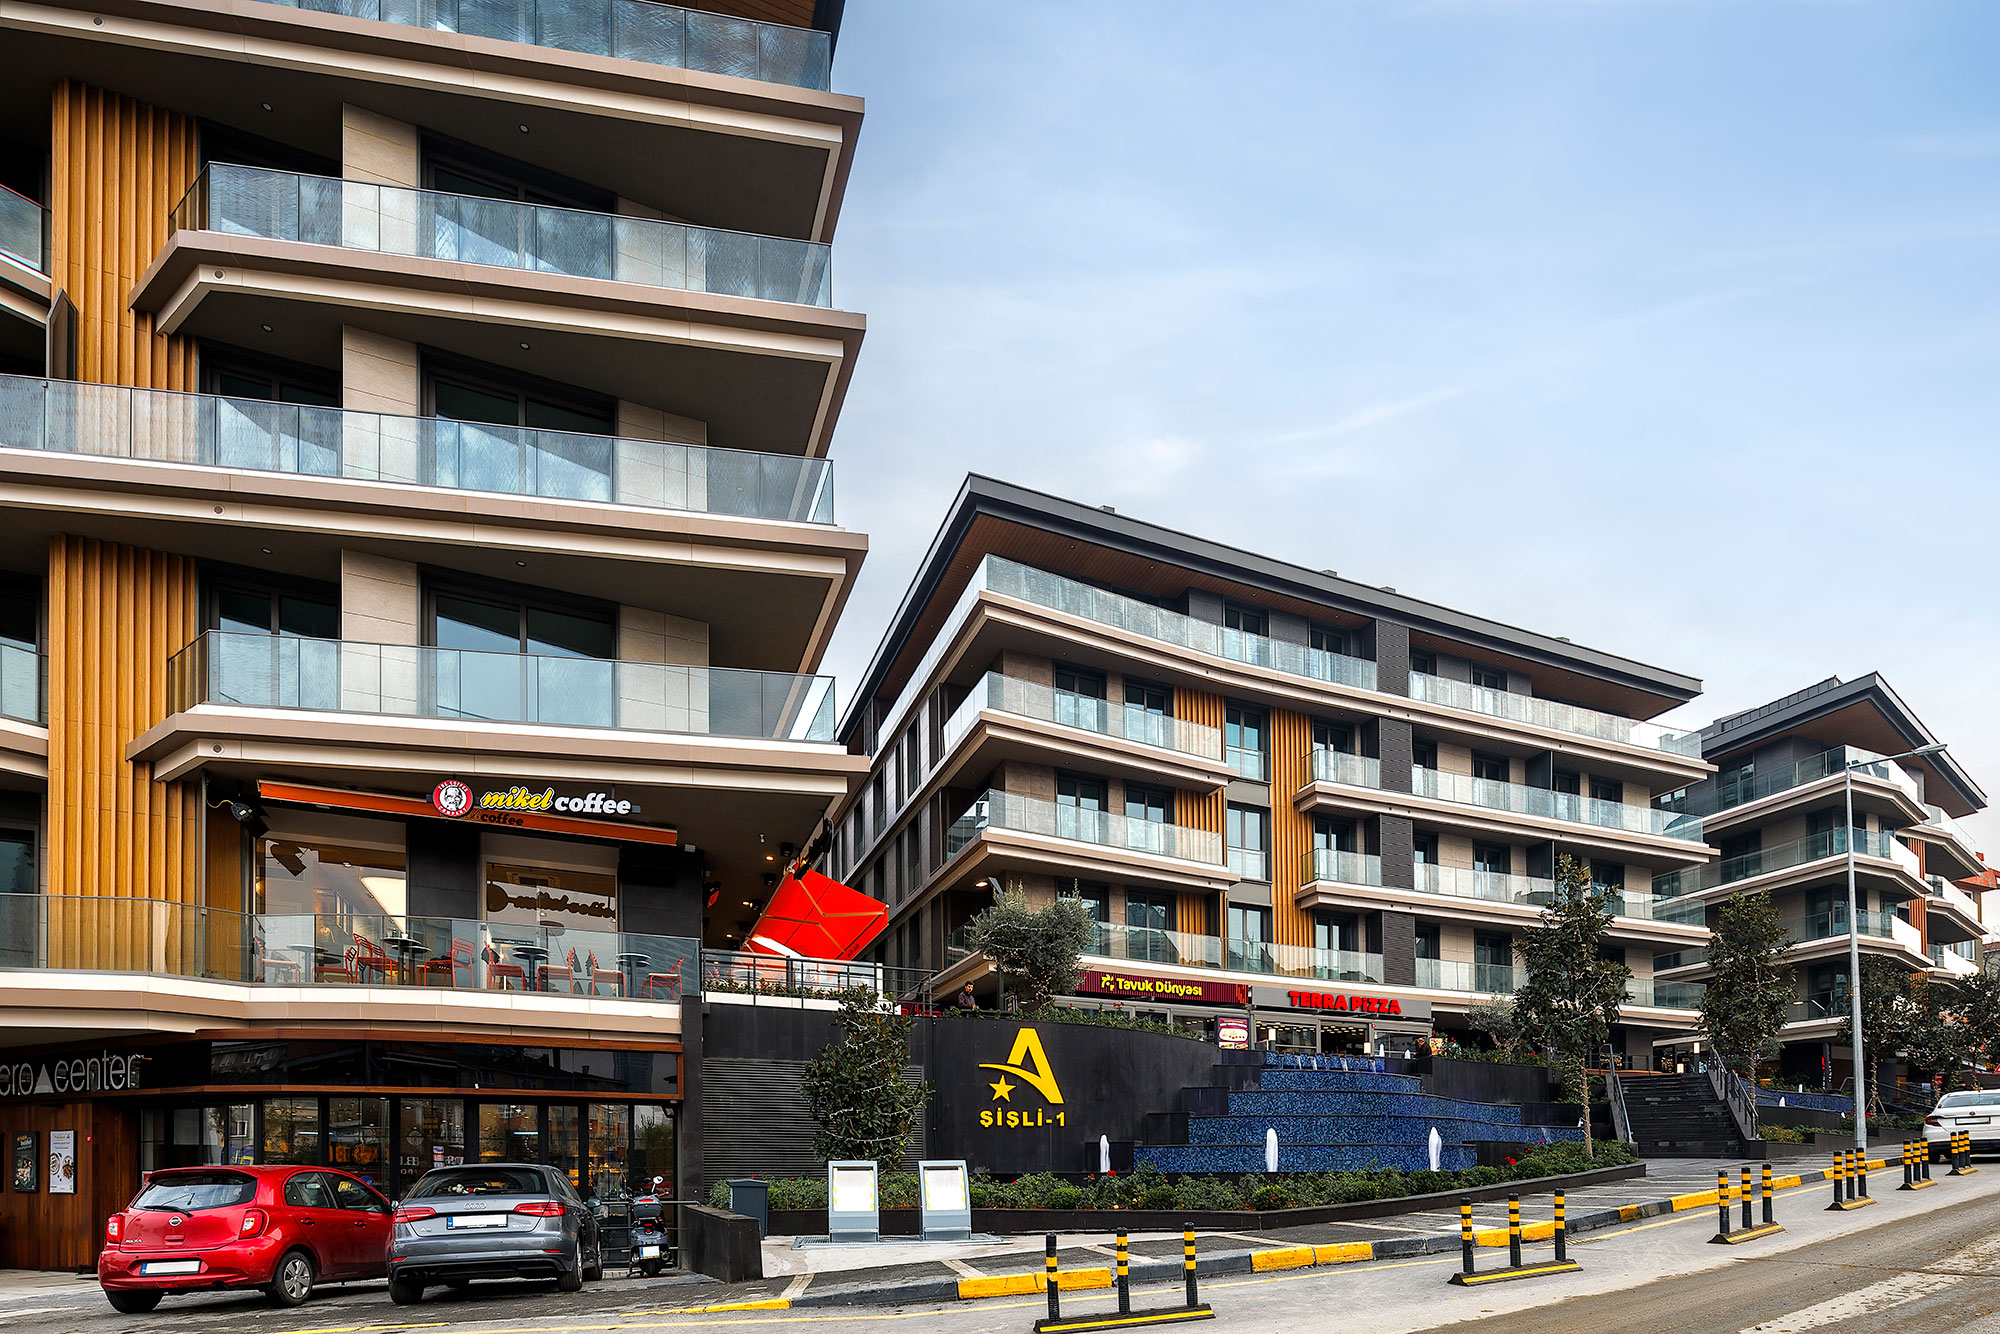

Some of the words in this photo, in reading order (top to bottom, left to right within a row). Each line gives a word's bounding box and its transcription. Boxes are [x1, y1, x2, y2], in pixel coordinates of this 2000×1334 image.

[480, 786, 554, 811] mikel
[554, 792, 632, 815] coffee
[480, 812, 524, 826] coffee
[1115, 976, 1153, 992] Tavuk
[1155, 980, 1203, 997] Dünyası
[1289, 990, 1349, 1010] TERRA
[55, 1050, 136, 1093] center
[980, 1107, 1065, 1128] ŞİŞLİ-1
